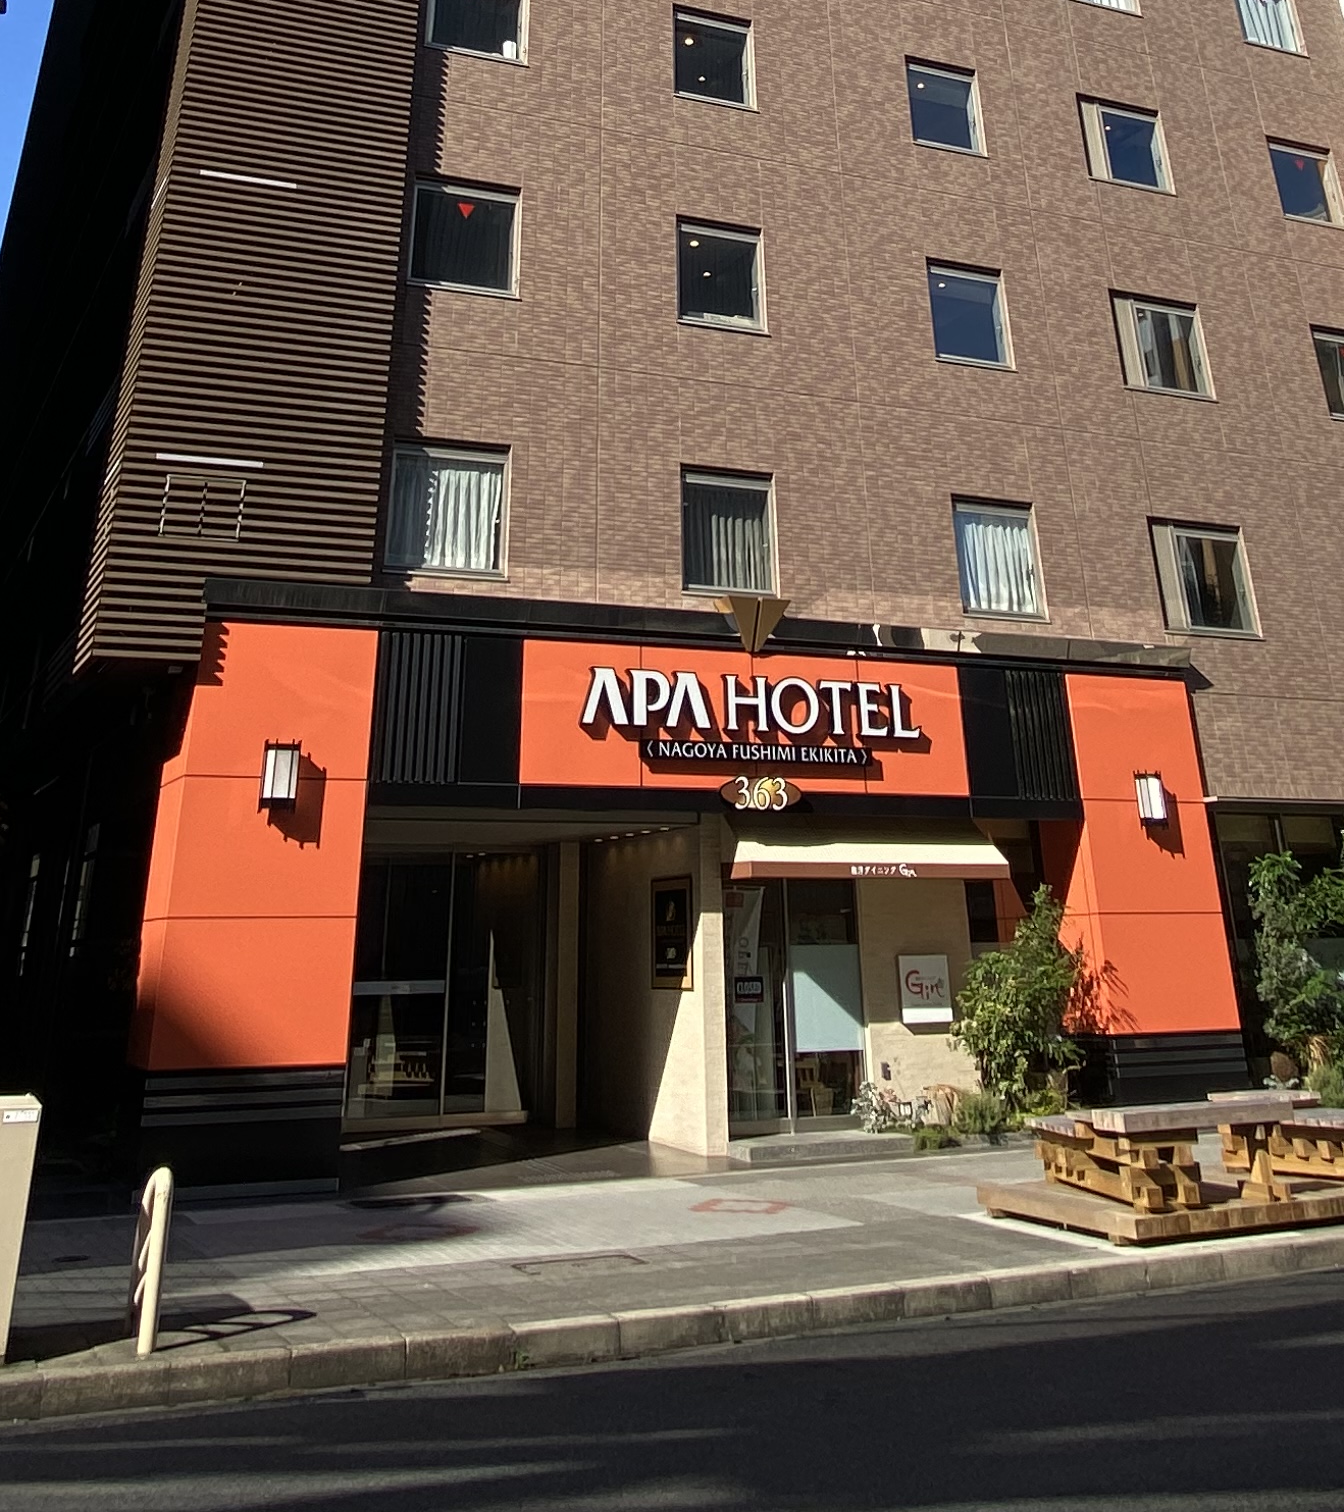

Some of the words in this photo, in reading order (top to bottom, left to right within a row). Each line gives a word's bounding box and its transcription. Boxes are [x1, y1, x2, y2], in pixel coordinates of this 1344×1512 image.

[581, 666, 712, 730] APA
[722, 674, 922, 739] HOTEL
[658, 741, 728, 759] NAGOYA
[732, 744, 796, 762] FUSHIMI
[734, 775, 789, 811] 363
